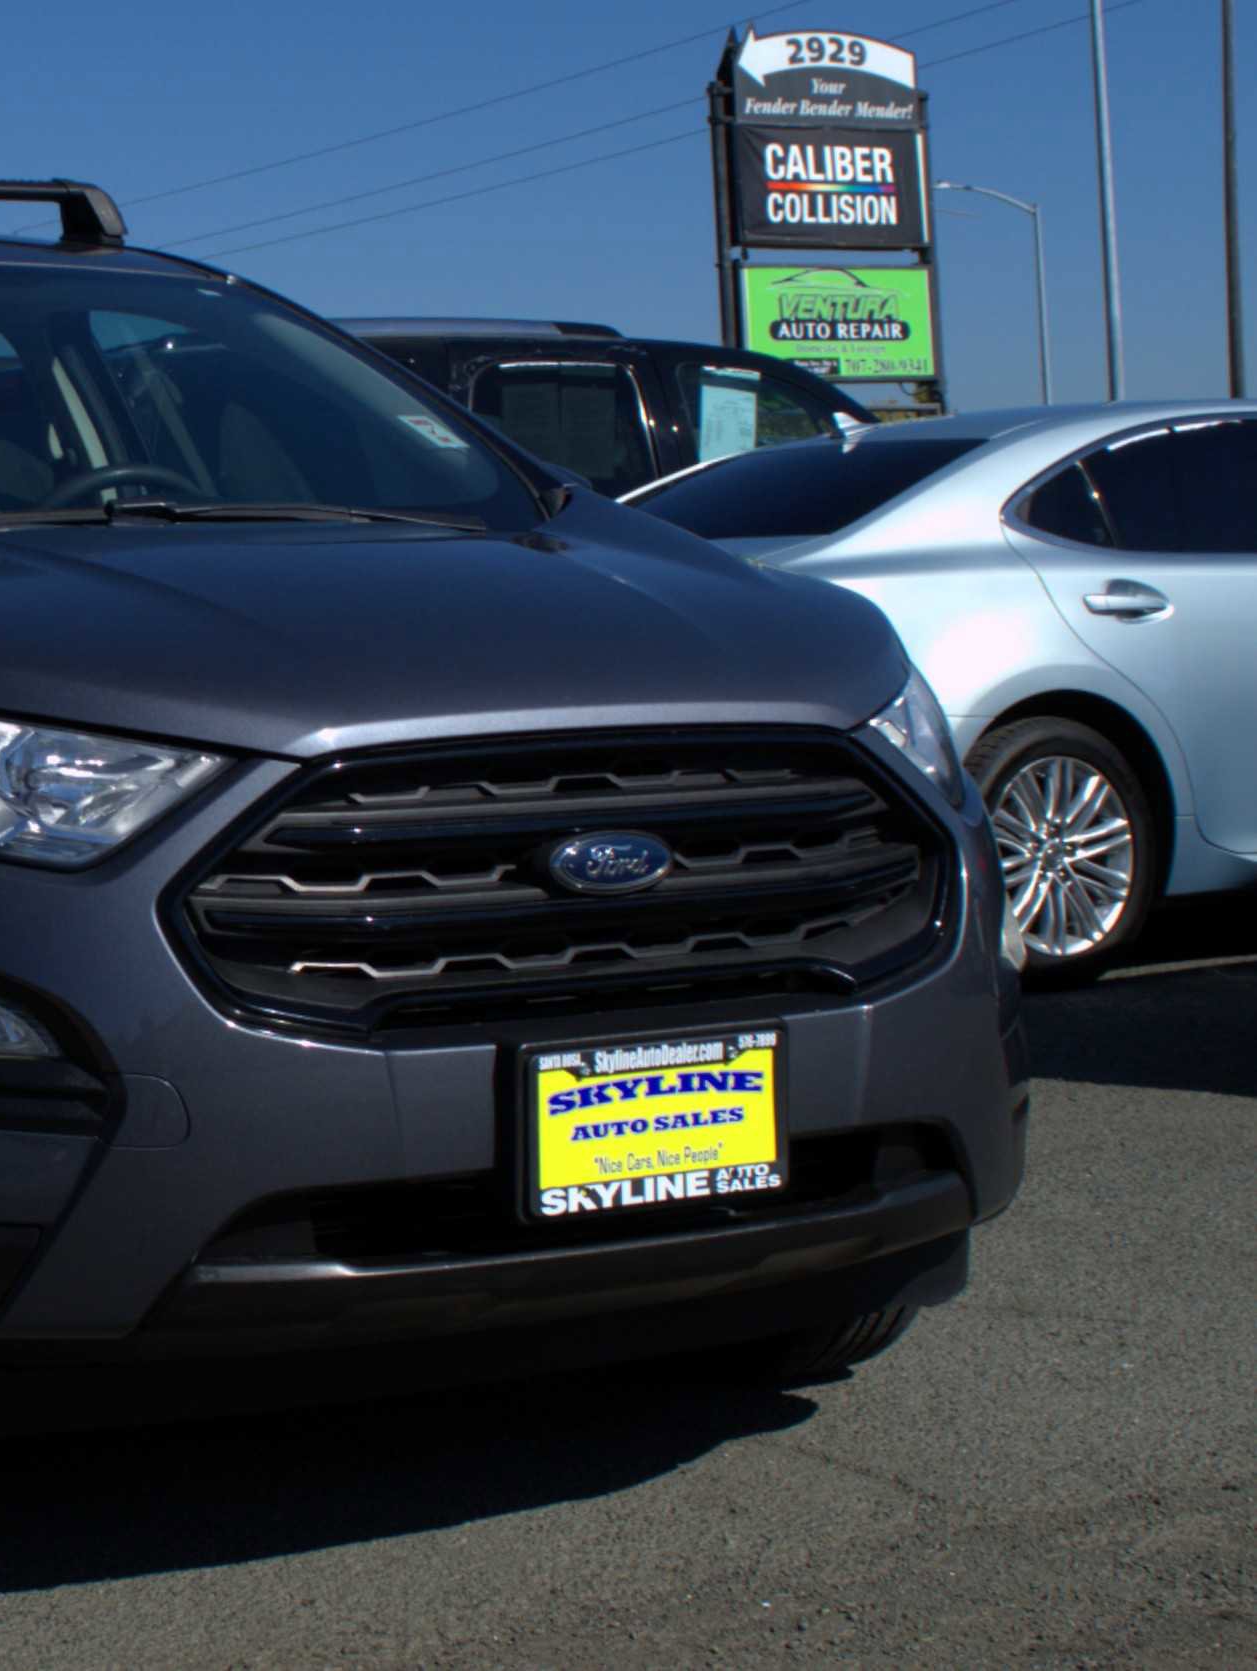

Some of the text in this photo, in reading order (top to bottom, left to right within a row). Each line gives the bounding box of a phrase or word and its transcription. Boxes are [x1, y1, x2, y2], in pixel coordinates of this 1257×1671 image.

[786, 36, 867, 67] 2929
[811, 77, 846, 95] Your
[744, 98, 797, 115] Fender
[799, 99, 852, 117] Bender
[765, 143, 894, 183] CALIBER
[767, 192, 898, 225] COLLISION
[778, 294, 900, 320] VENTURA
[777, 322, 904, 339] AUTO REPAIR
[548, 1071, 764, 1116] SKYLINE
[571, 1107, 744, 1142] AUTO SALES
[656, 1150, 681, 1168] Nice
[541, 1169, 711, 1217] SKYLINE
[715, 1174, 782, 1195] SALES
